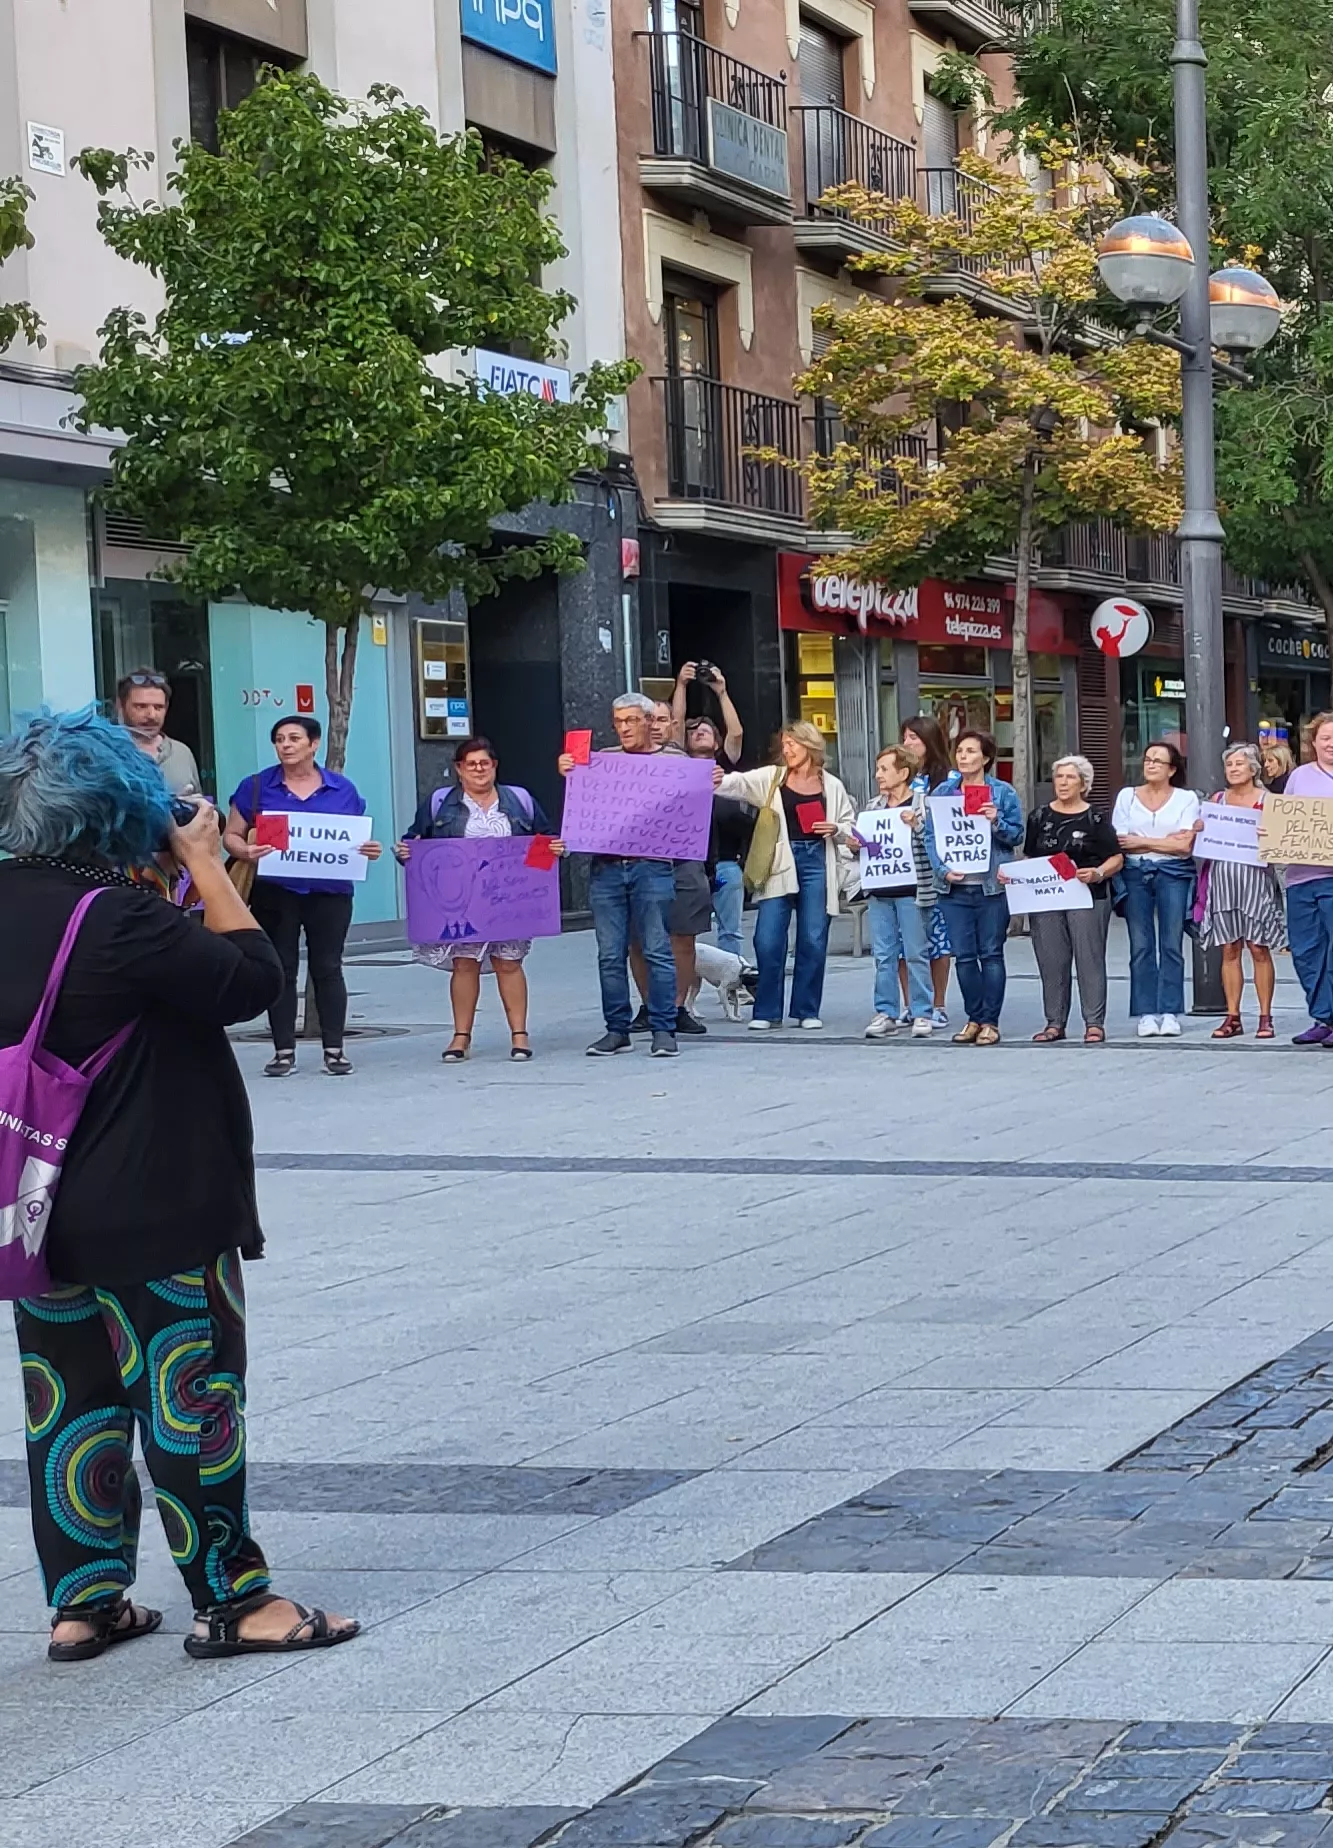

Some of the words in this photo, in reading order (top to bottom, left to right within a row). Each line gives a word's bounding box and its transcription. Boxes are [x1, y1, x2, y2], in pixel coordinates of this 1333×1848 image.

[945, 615, 1002, 641] telepizza.es
[1268, 637, 1302, 656] cache
[1311, 643, 1330, 659] cac
[1272, 799, 1307, 816] POR
[1312, 800, 1328, 818] EL
[876, 818, 891, 831] NI
[951, 820, 976, 832] UN
[1285, 820, 1309, 835] DEL
[288, 826, 302, 838] NI
[310, 827, 351, 842] UNA
[873, 833, 894, 845] UN
[945, 833, 985, 848] PASO
[280, 850, 349, 865] MENOS
[869, 847, 903, 861] ASO
[943, 846, 988, 864] ATRÁS
[865, 859, 912, 877] ATRÁS
[1034, 886, 1065, 896] MATA
[55, 1137, 68, 1151] S
